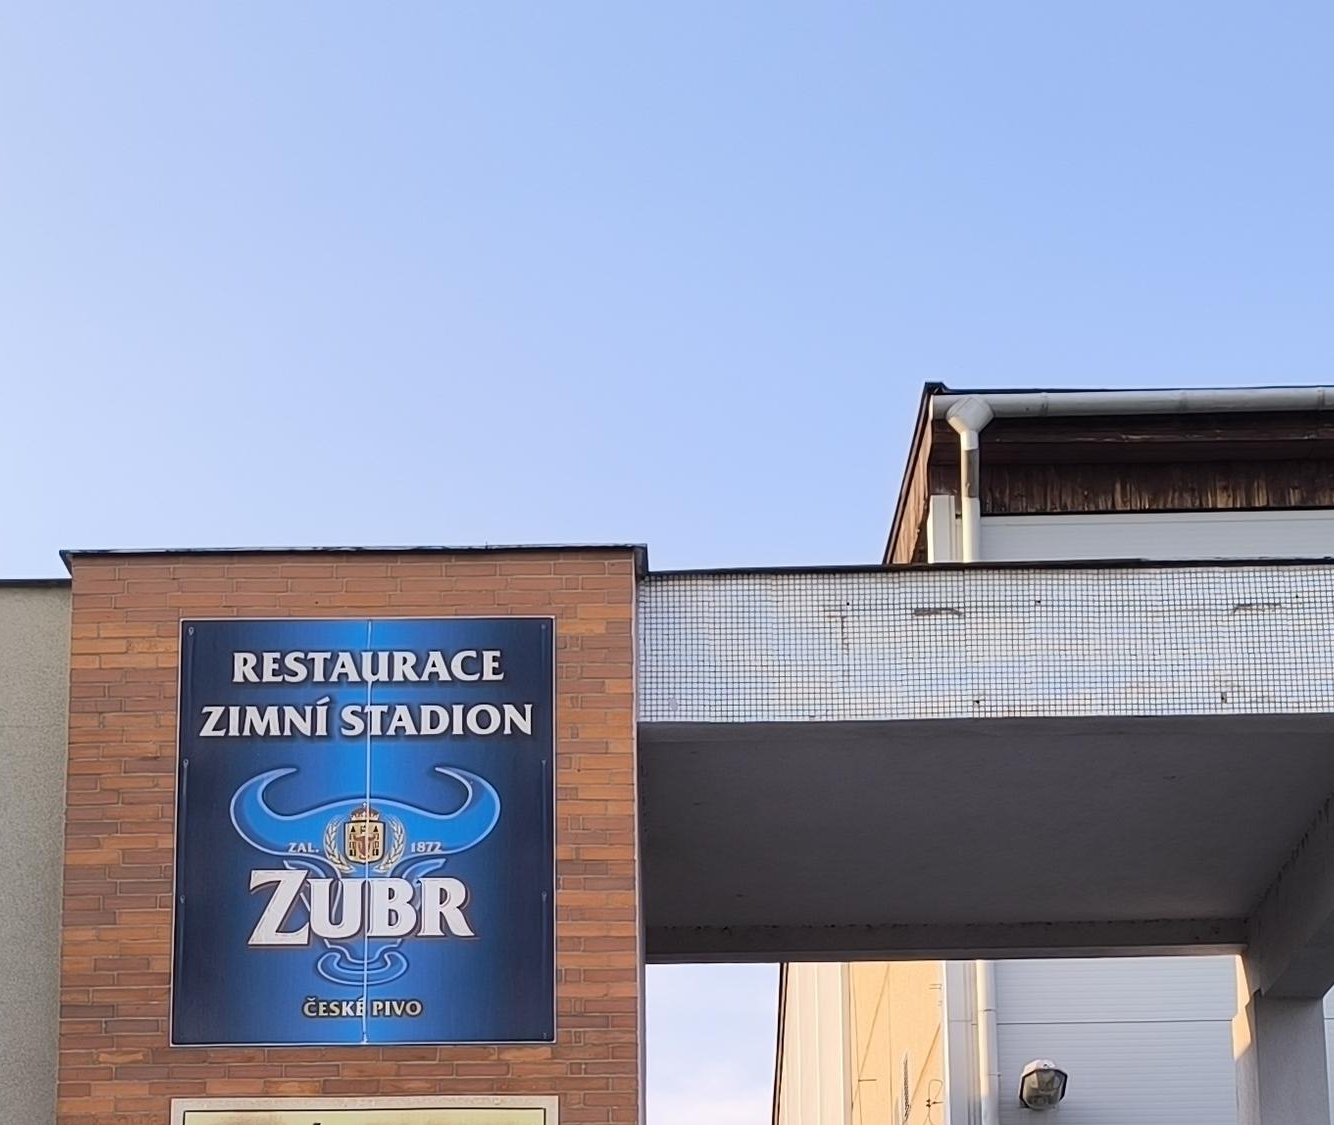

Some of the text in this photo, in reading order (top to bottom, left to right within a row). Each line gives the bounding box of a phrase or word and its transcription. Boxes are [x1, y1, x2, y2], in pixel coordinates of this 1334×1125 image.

[232, 650, 504, 683] RESTAURACE
[199, 696, 533, 737] ZIMNÍ STADION
[410, 841, 443, 853] 1872
[247, 869, 475, 946] ZUBR
[303, 997, 422, 1017] ČESKÉ PIVO
